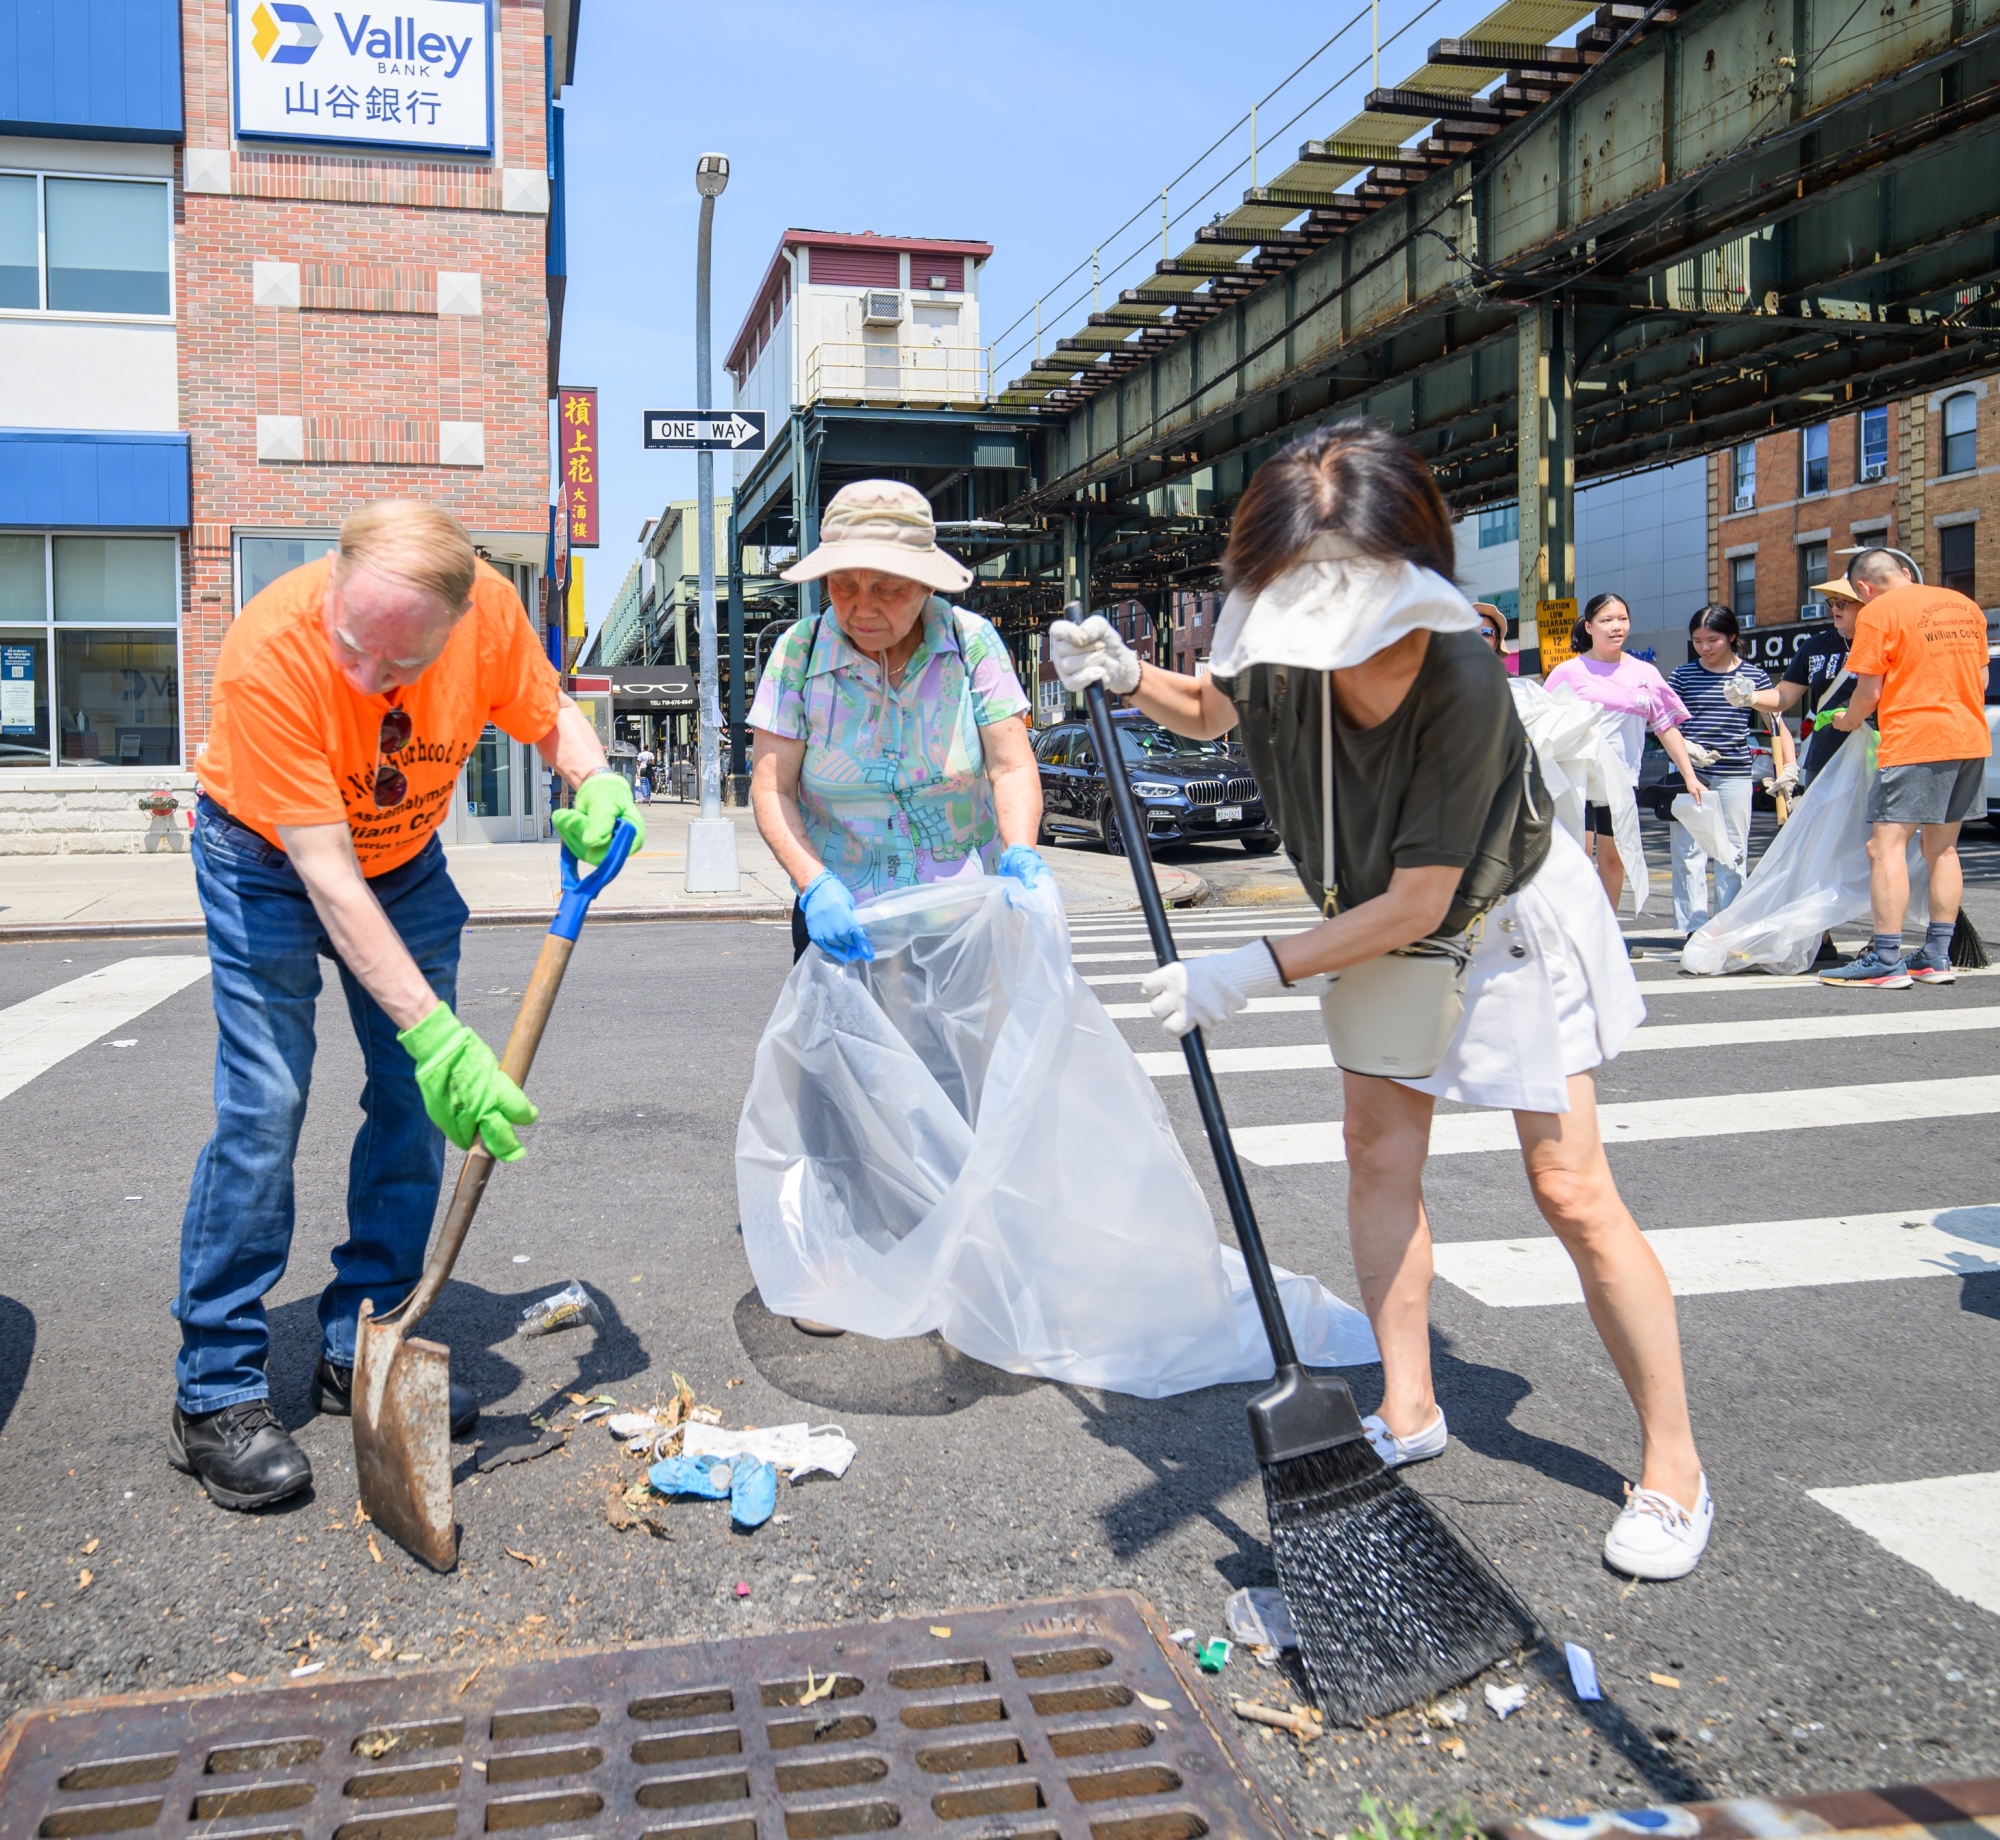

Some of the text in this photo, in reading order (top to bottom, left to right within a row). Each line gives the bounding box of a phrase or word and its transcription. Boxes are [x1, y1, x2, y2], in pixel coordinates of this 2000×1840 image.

[334, 11, 473, 79] Valley
[378, 62, 430, 78] BANK
[285, 81, 442, 125] 山谷銀行
[661, 422, 748, 439] ONE WAY
[1542, 602, 1570, 611] CAUTION
[1550, 611, 1563, 619] LOW
[1548, 627, 1569, 636] AHEAD
[1763, 659, 1780, 668] TEA
